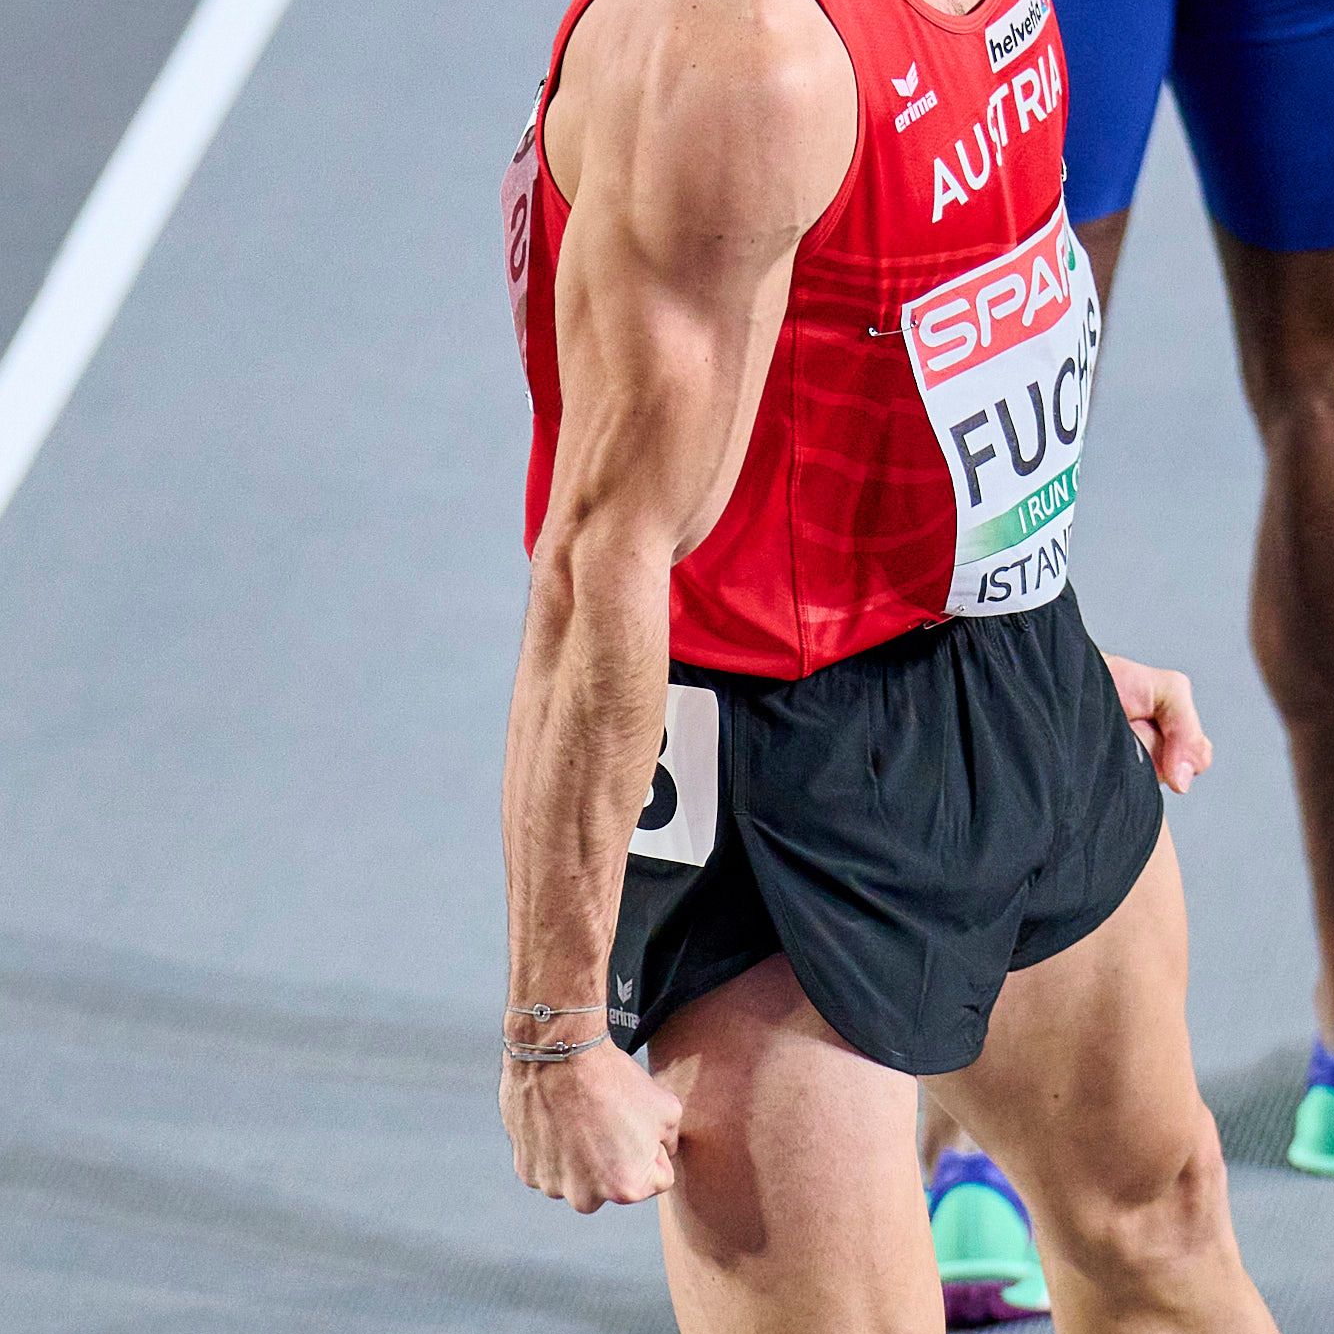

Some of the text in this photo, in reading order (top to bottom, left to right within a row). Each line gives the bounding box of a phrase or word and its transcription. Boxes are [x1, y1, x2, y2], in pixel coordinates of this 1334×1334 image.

[988, 0, 1042, 64] helvetia
[894, 90, 939, 134] erima
[931, 44, 1063, 224] AUSTRIA
[1017, 505, 1028, 535] I
[1027, 474, 1070, 527] RUN
[976, 524, 1073, 604] ISTAN
